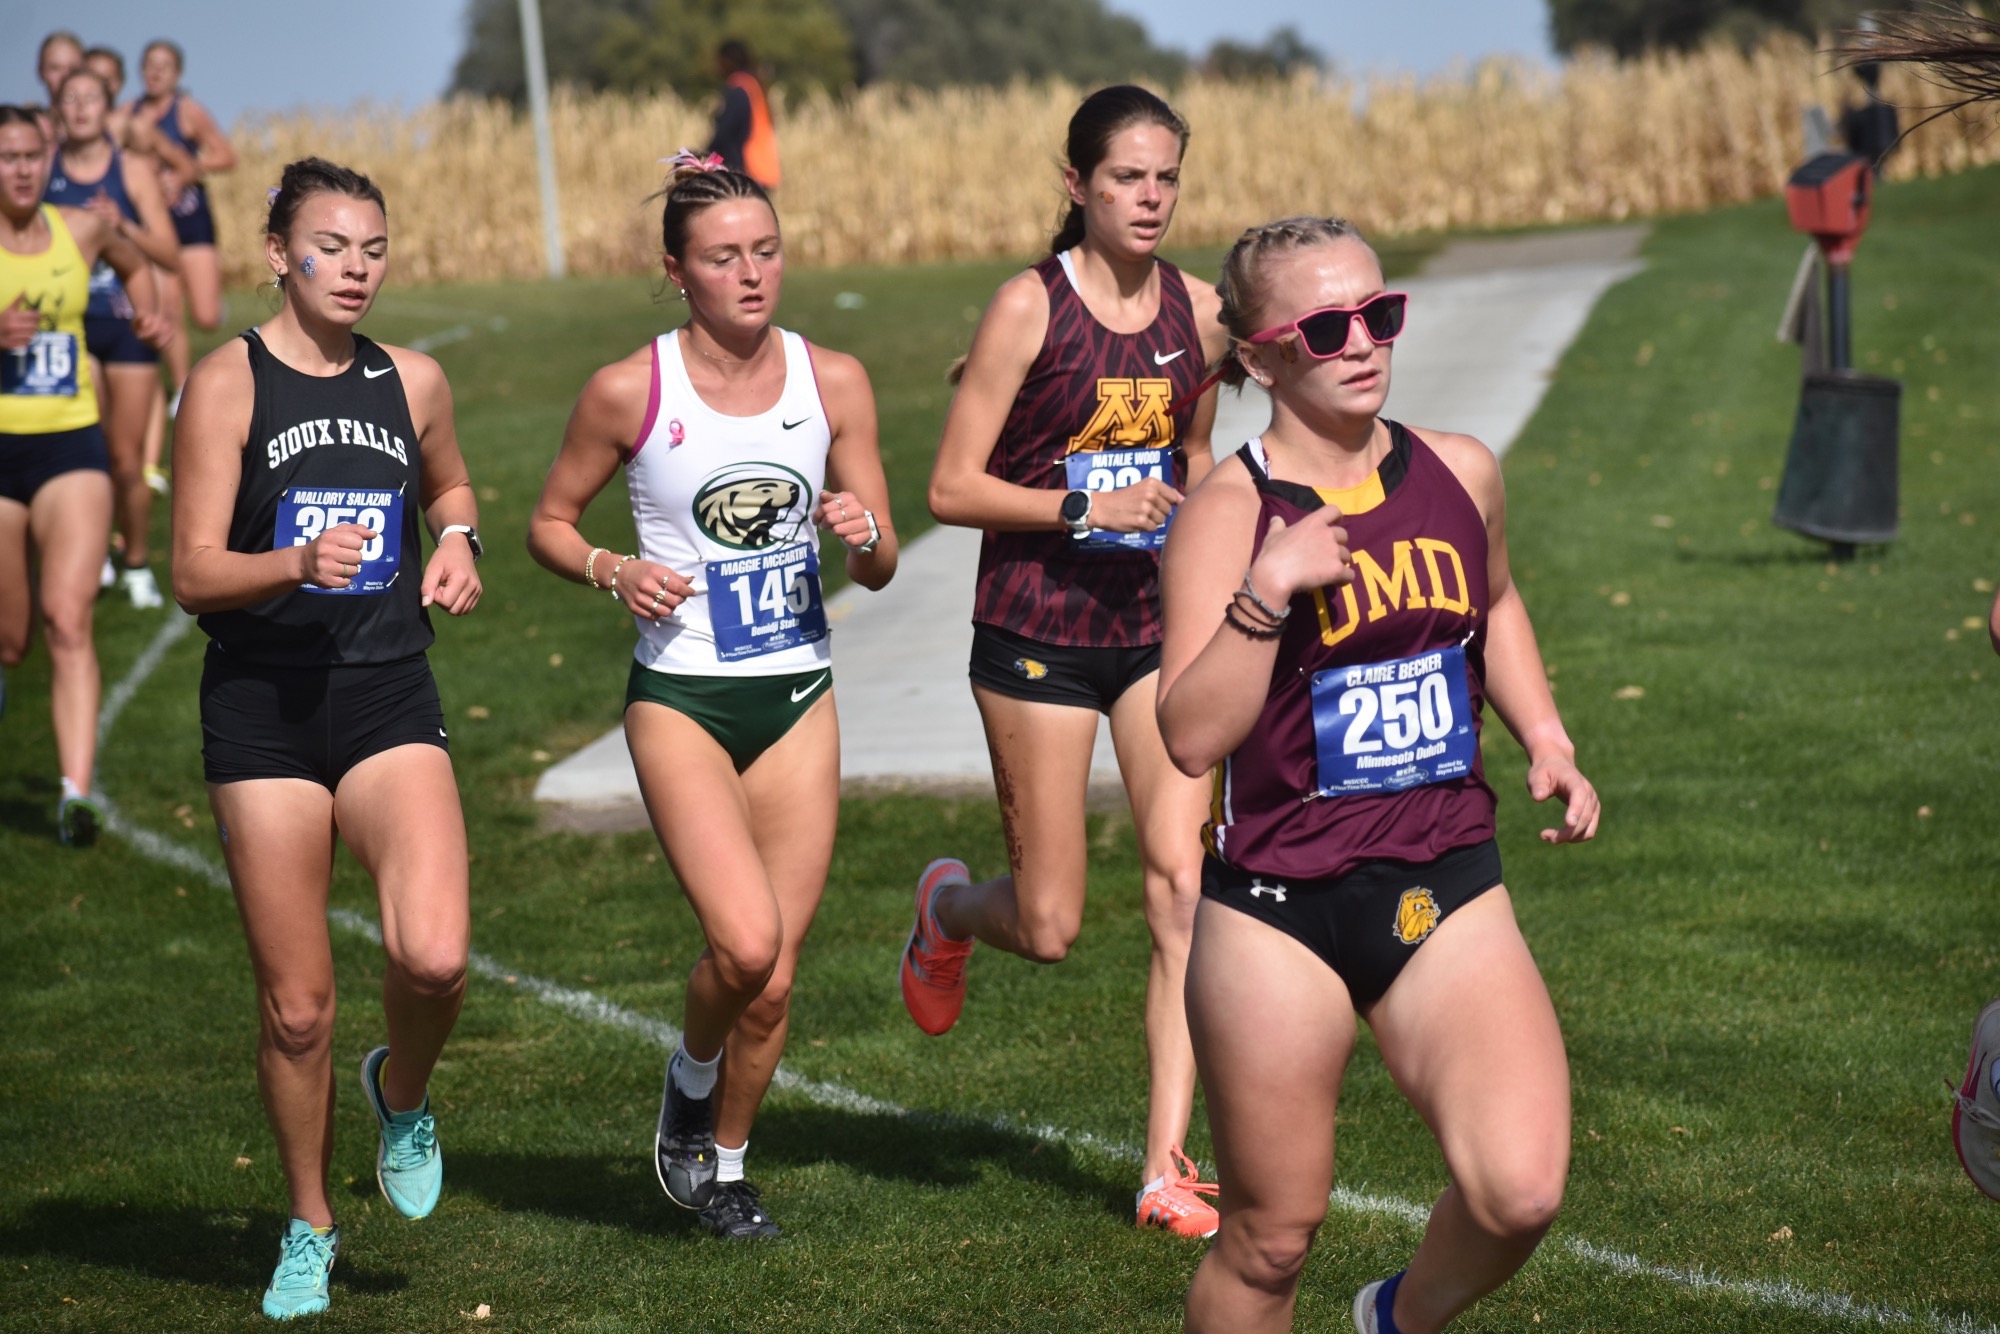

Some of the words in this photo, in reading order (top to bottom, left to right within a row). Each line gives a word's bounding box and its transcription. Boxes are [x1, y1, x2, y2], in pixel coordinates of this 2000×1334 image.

[267, 418, 335, 470] SIOUX
[337, 418, 409, 467] FALLS
[1092, 453, 1133, 468] NATALIE
[1134, 451, 1161, 466] WOOD
[293, 491, 344, 506] MALLORY
[346, 492, 392, 506] SALAZAR
[720, 558, 762, 576] MAGGIE
[762, 545, 808, 569] MCCARTHY
[729, 562, 810, 626] 145
[751, 621, 779, 637] Bemidji
[779, 617, 800, 631] State
[1346, 665, 1395, 688] CLAIRE
[1398, 653, 1442, 681] BECKER
[1338, 672, 1454, 755] 250
[1356, 751, 1414, 770] Minnesota
[1416, 740, 1447, 760] Duluth
